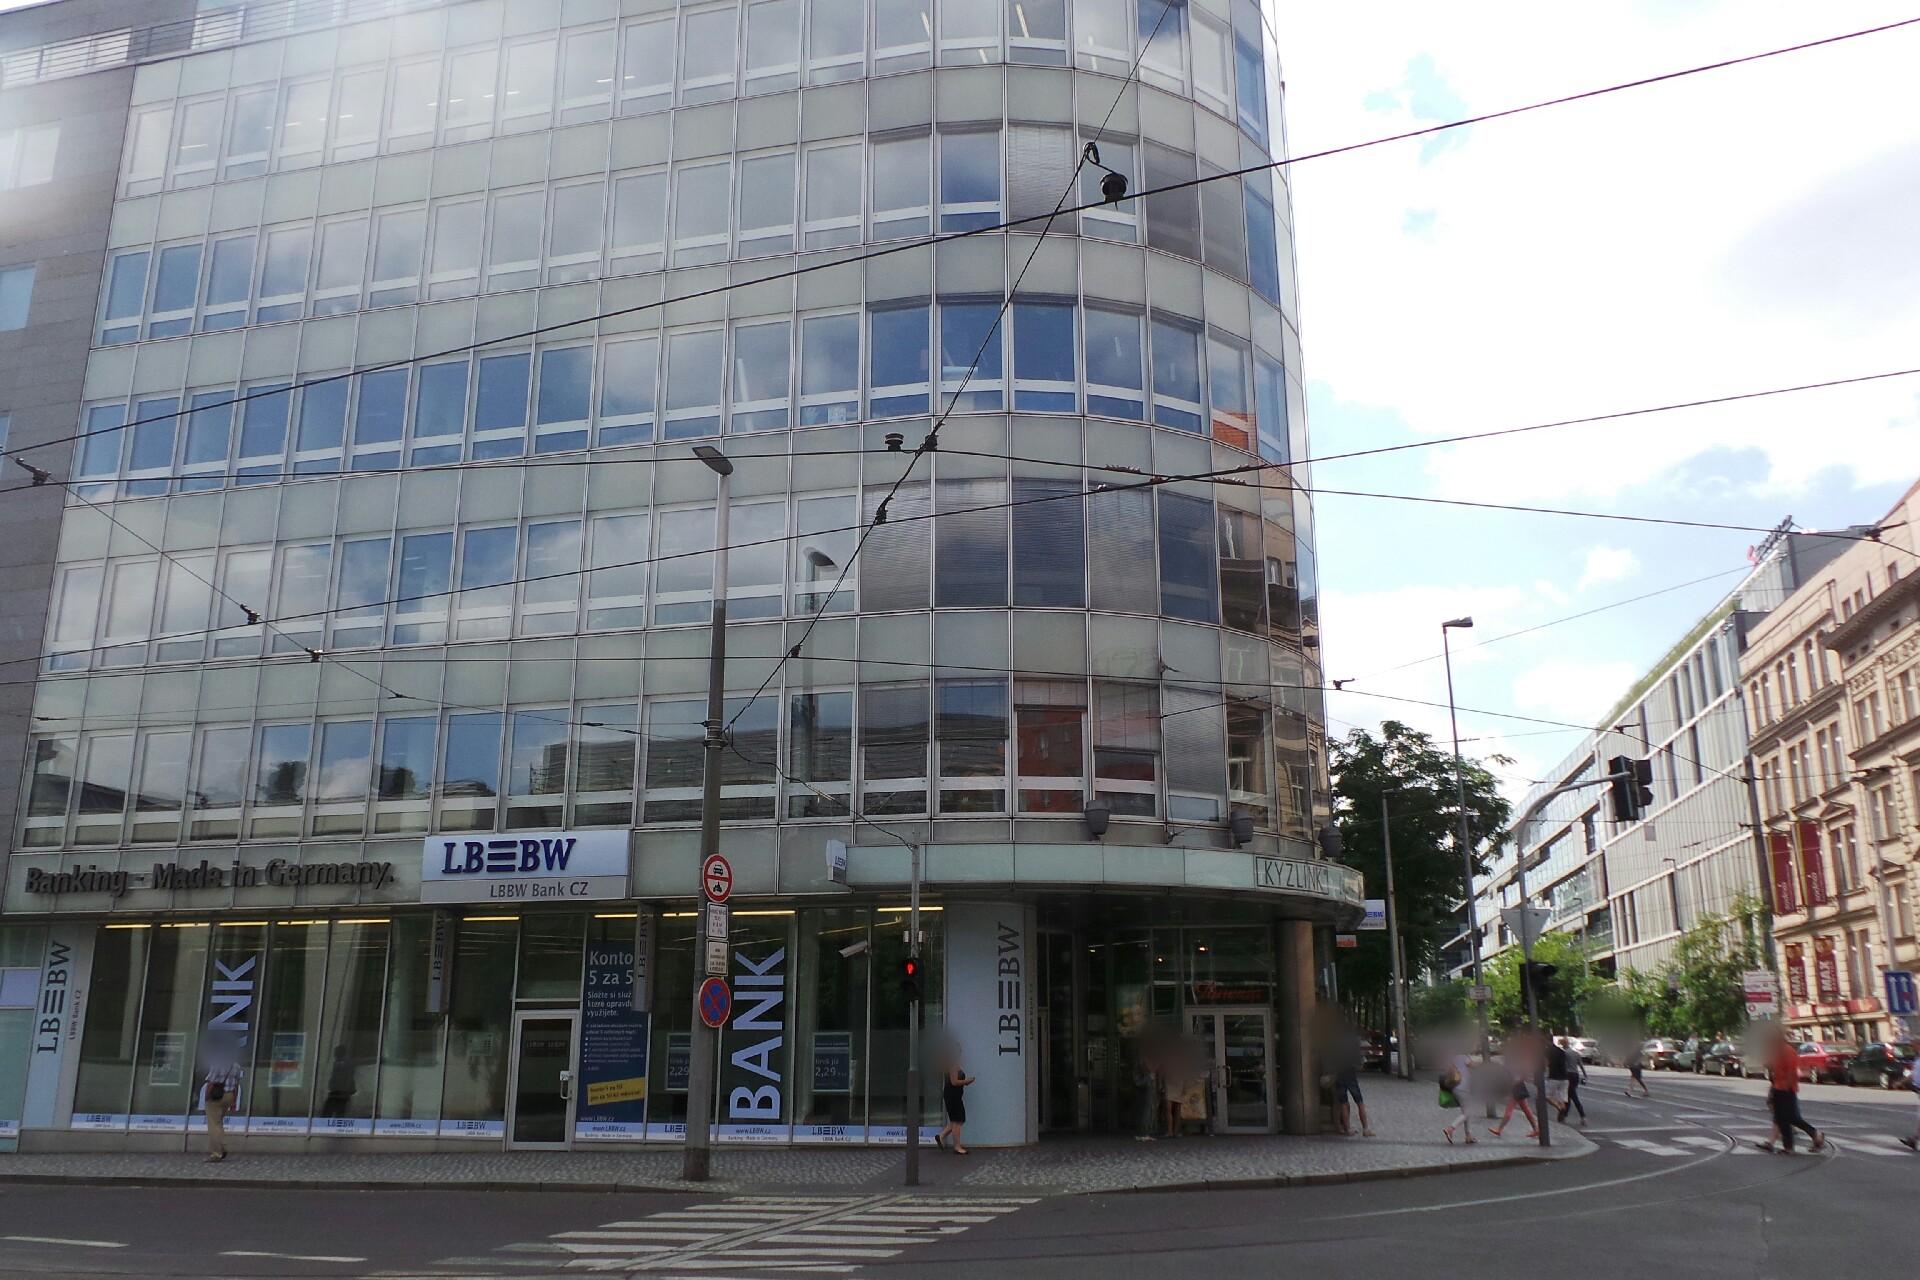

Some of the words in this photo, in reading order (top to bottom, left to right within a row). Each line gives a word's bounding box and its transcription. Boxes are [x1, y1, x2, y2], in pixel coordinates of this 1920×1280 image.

[25, 864, 128, 897] Banking
[152, 860, 223, 889] Made
[232, 860, 255, 887] in
[265, 858, 395, 889] Germany.
[490, 883, 528, 898] LBBW
[532, 882, 564, 896] Bank
[570, 882, 588, 896] CZ
[590, 950, 634, 966] Konto
[589, 970, 598, 985] 5
[602, 973, 620, 985] za
[729, 946, 785, 1120] BANK
